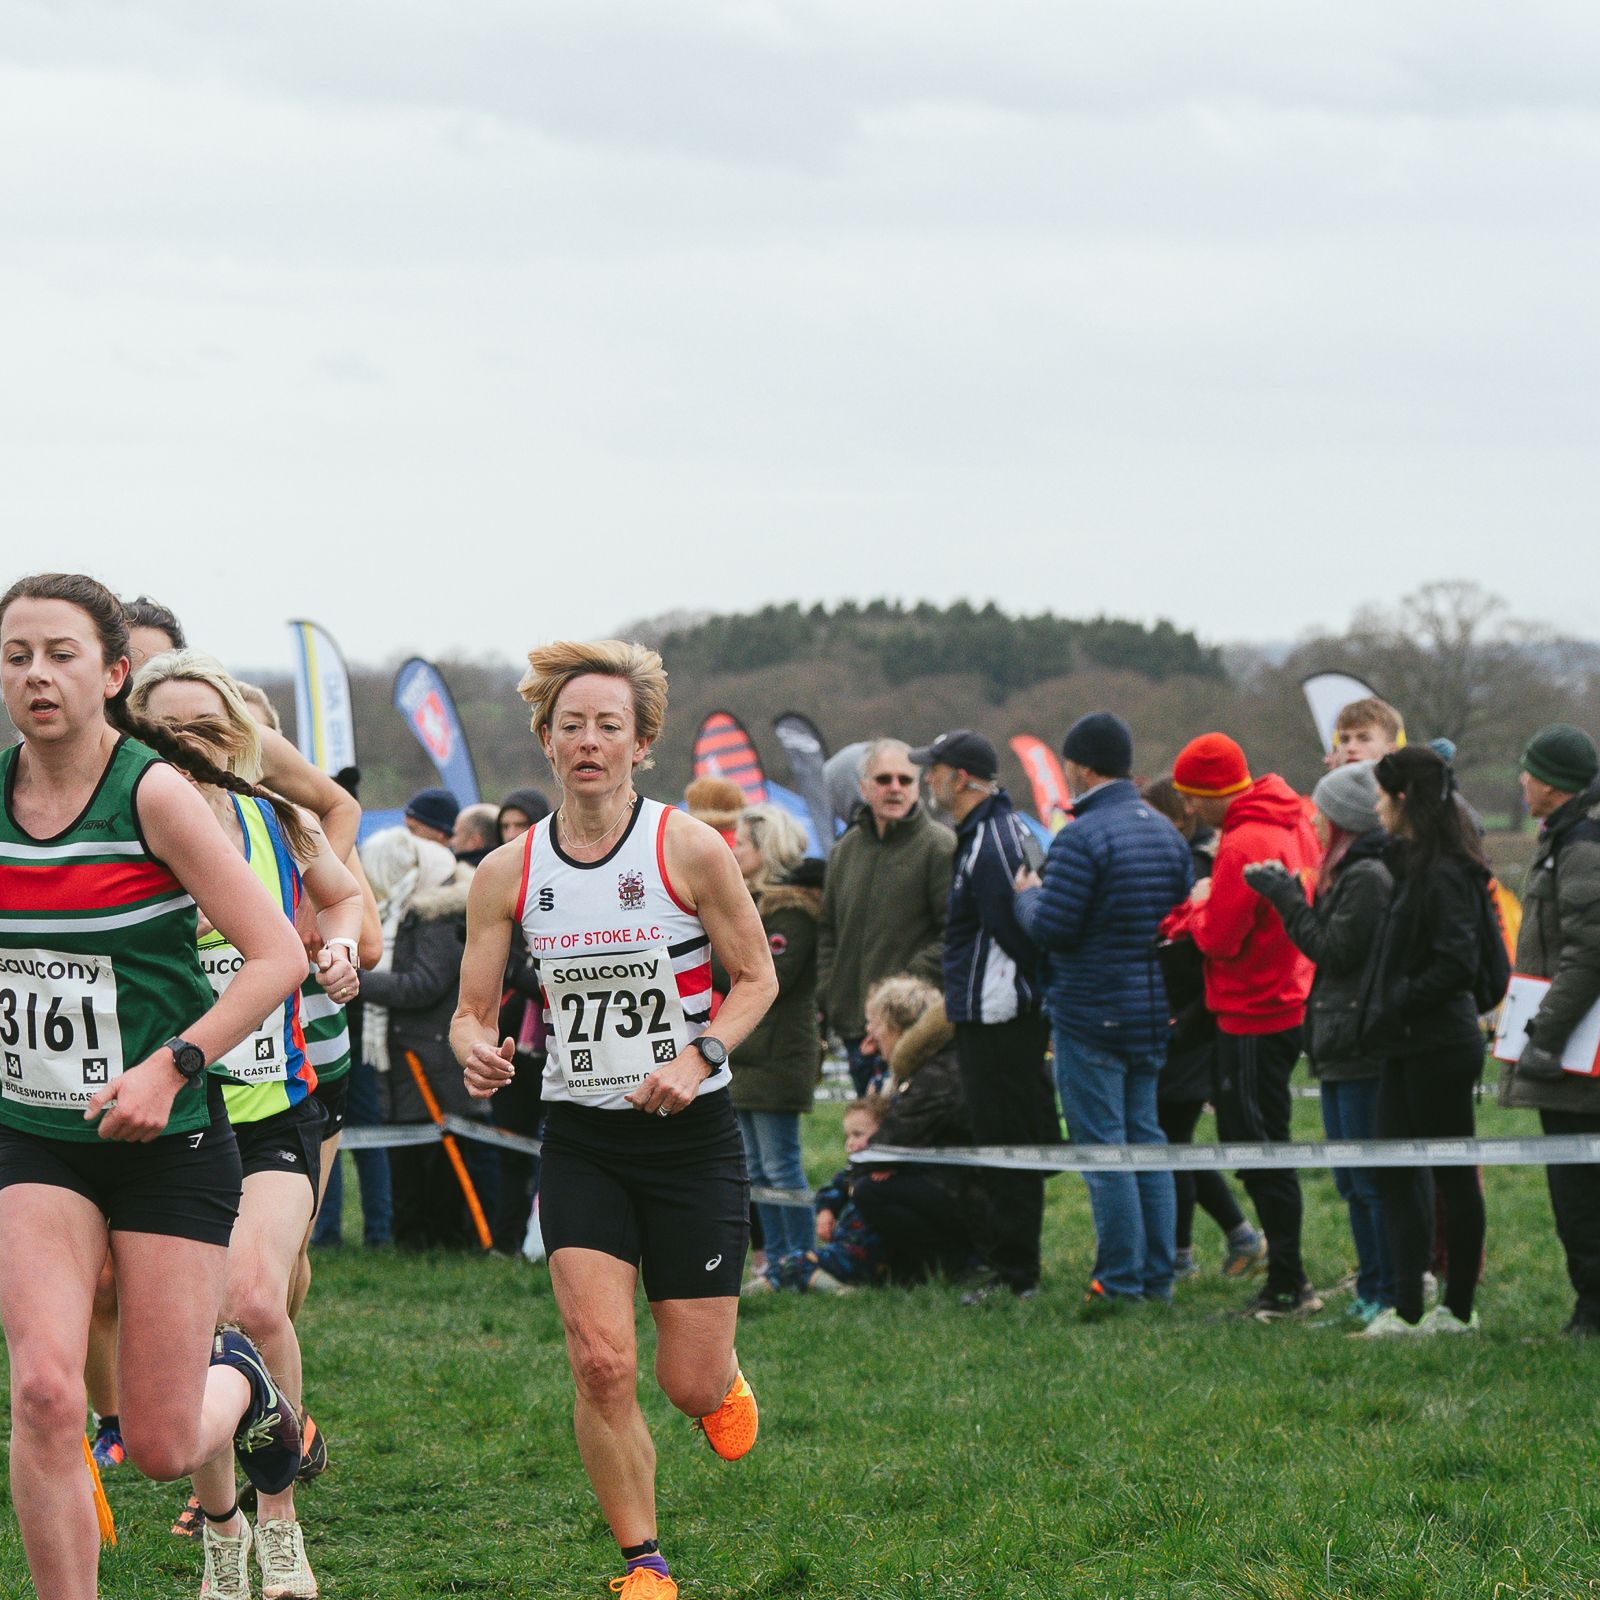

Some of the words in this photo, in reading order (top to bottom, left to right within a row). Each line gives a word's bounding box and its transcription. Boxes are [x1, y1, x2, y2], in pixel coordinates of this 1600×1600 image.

[534, 937, 557, 951] CITY
[560, 934, 580, 947] OF
[584, 929, 632, 946] STOKE
[635, 927, 665, 942] A.C.
[552, 959, 659, 984] saucony
[561, 988, 671, 1044] 2732
[244, 1064, 281, 1077] CASTLE
[568, 1073, 640, 1088] BOLESWORTH
[5, 1081, 67, 1101] BOLESWORTH
[69, 1091, 99, 1102] CAS
